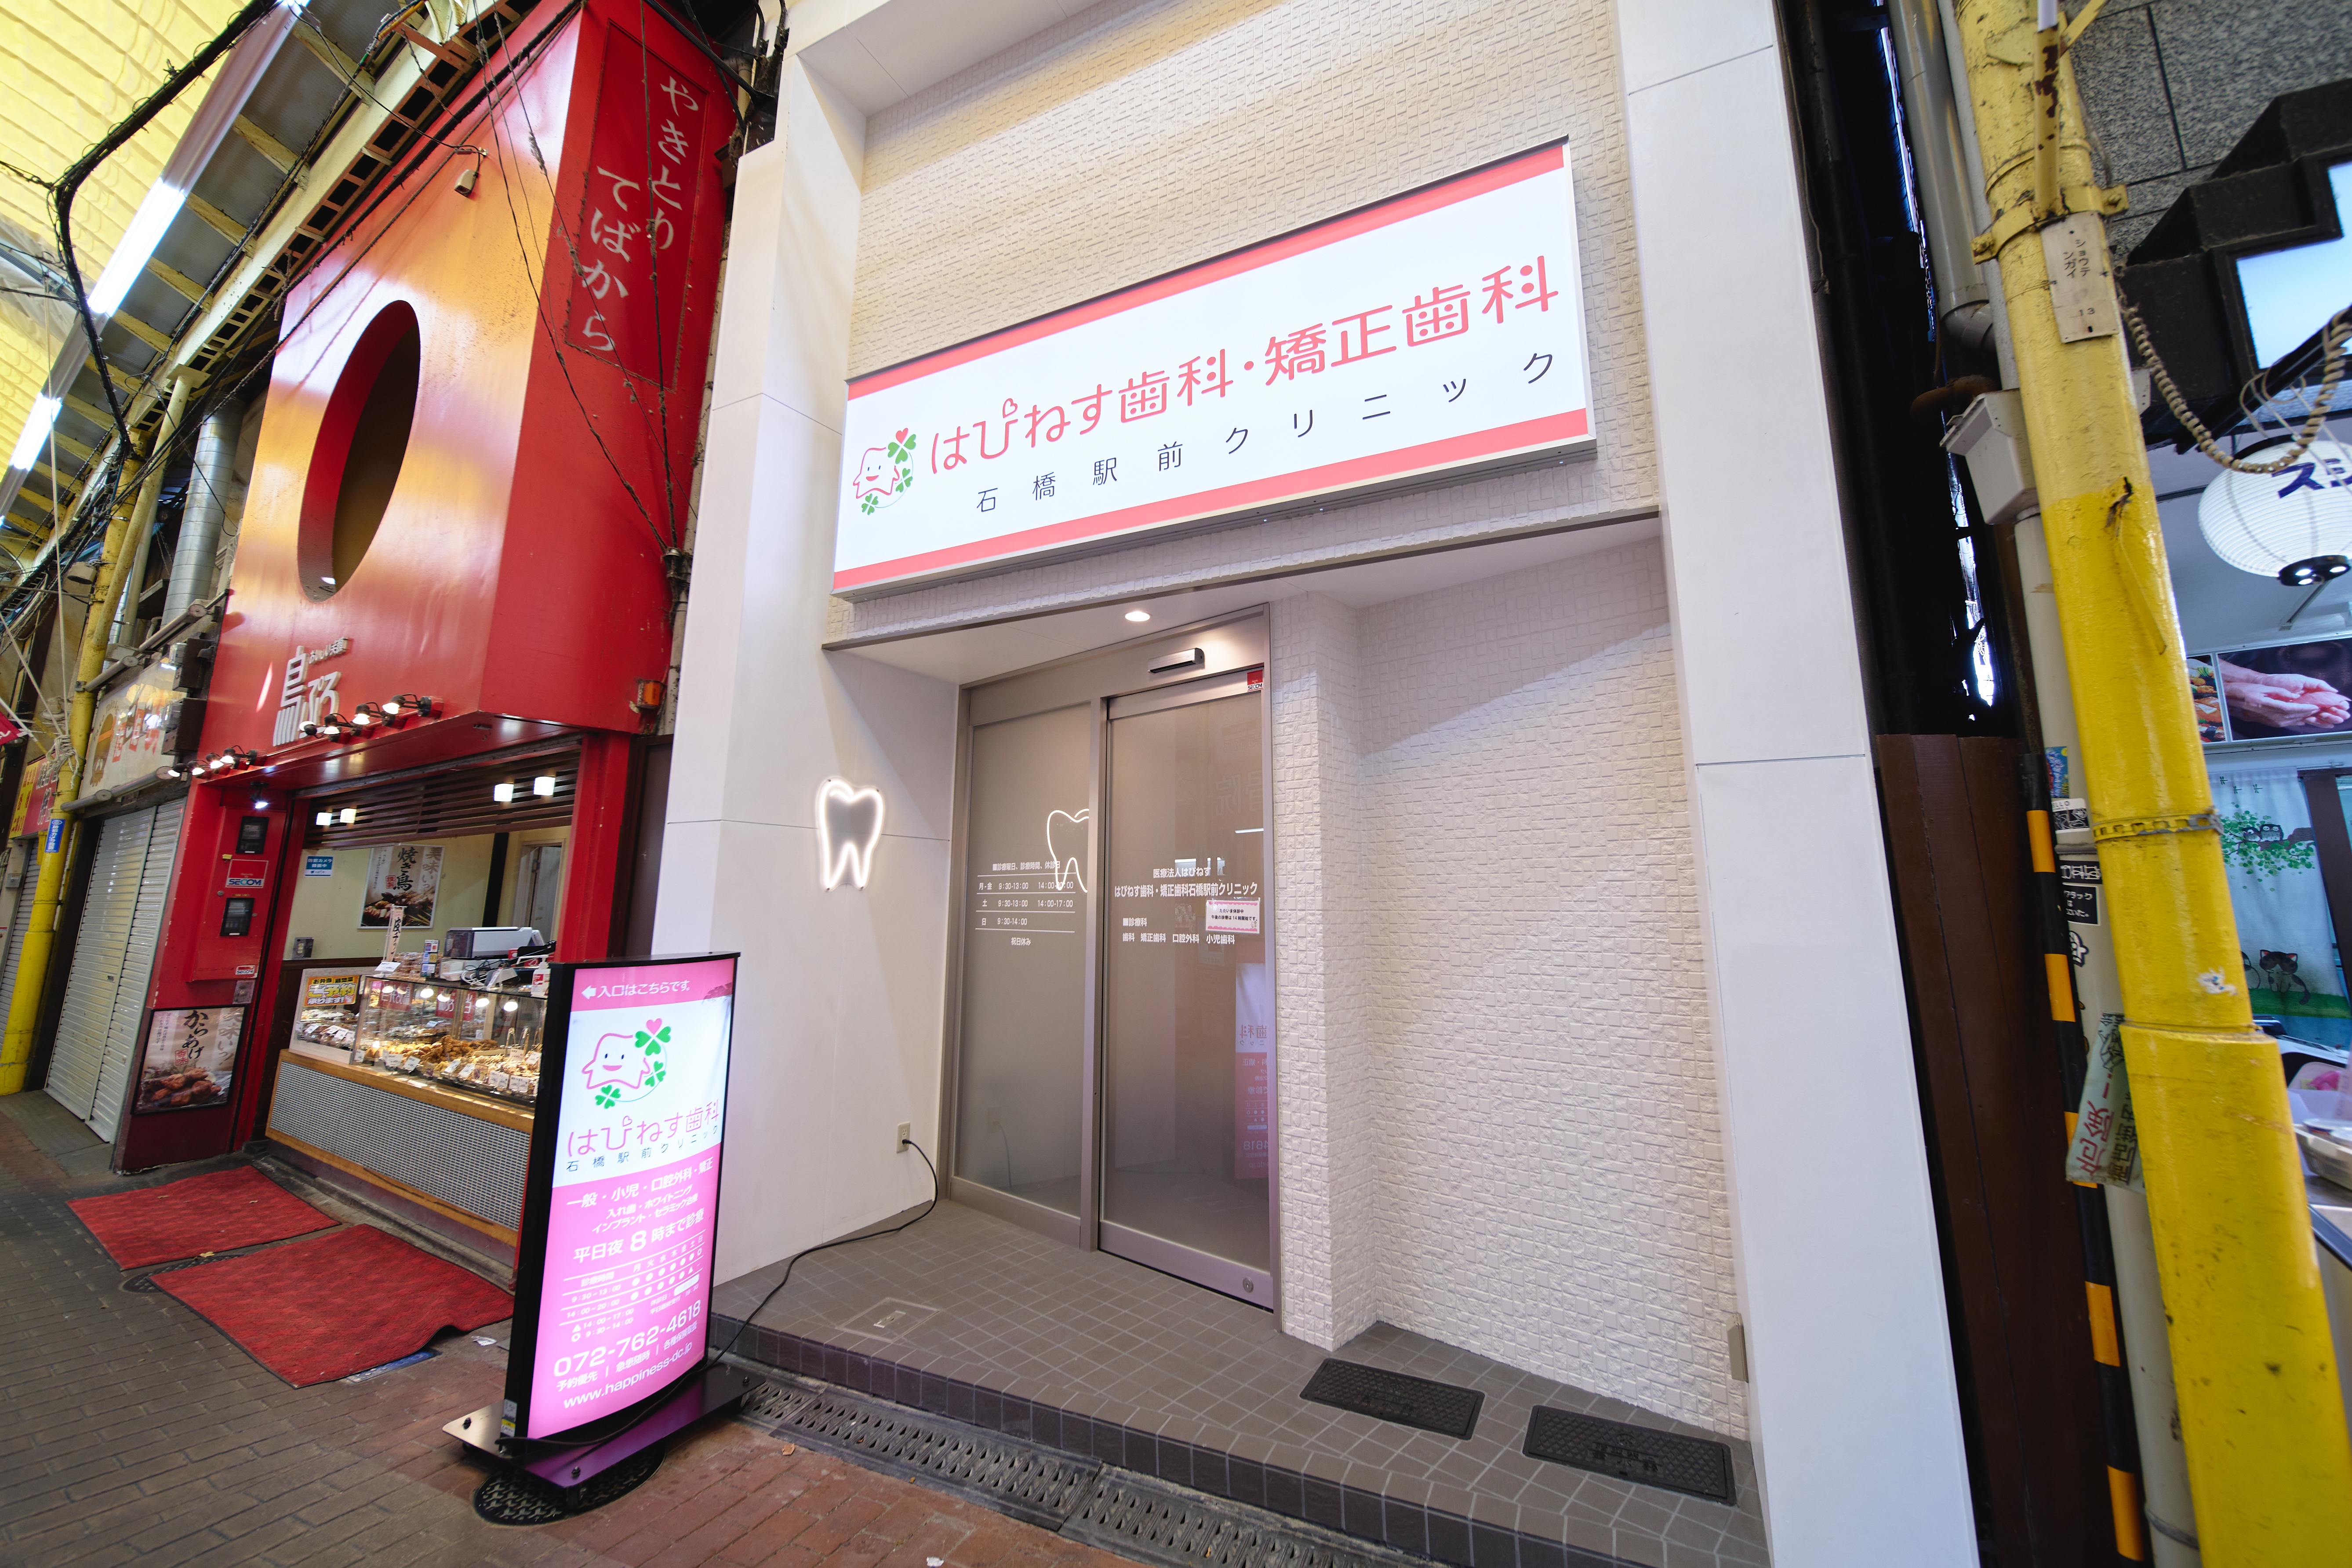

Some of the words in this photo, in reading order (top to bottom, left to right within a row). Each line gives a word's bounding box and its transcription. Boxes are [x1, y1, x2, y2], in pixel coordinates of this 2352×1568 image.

[650, 76, 698, 250] やきとり
[581, 166, 641, 352] てばから
[931, 255, 1560, 475] はぴねす歯科・矯正歯科
[975, 352, 1554, 513] 石橋駅前クリニック
[394, 847, 418, 891] 焼き鳥
[1115, 881, 1258, 897] はぴねす歯科・矯正歯科石橋駅前クリニック
[1153, 867, 1211, 878] 医療法人はぴねす
[1011, 937, 1031, 946] 祝日休み
[1123, 932, 1135, 942] 歯科
[1141, 932, 1166, 942] 矯正歯科
[1172, 934, 1200, 943] 口腔外科
[1206, 934, 1235, 944] 小児歯科
[1129, 917, 1147, 926] 診療科
[307, 983, 356, 998] ご予約
[597, 979, 691, 998] 入口はこちらです。
[182, 1010, 209, 1059] からあげ
[566, 1125, 718, 1172] 石橋駅前クリニック
[568, 1099, 719, 1157] はぴねす歯科
[567, 1157, 714, 1208] 一般・小児・口腔外科・矯正
[606, 1184, 693, 1219] 入れ歯・ホワイトニング
[592, 1193, 699, 1234] インプラント・セラミック治療
[633, 1263, 641, 1273] 月
[646, 1259, 655, 1268] 火
[659, 1254, 667, 1263] 水
[671, 1249, 678, 1258] 木
[681, 1244, 687, 1253] 金
[690, 1240, 696, 1248] 土
[698, 1234, 703, 1243] 日
[553, 1299, 702, 1377] 072-762-4618
[556, 1370, 599, 1392] 予約優先
[615, 1349, 651, 1373] 急患随時
[563, 1341, 693, 1409] www.happiness-dc.jp
